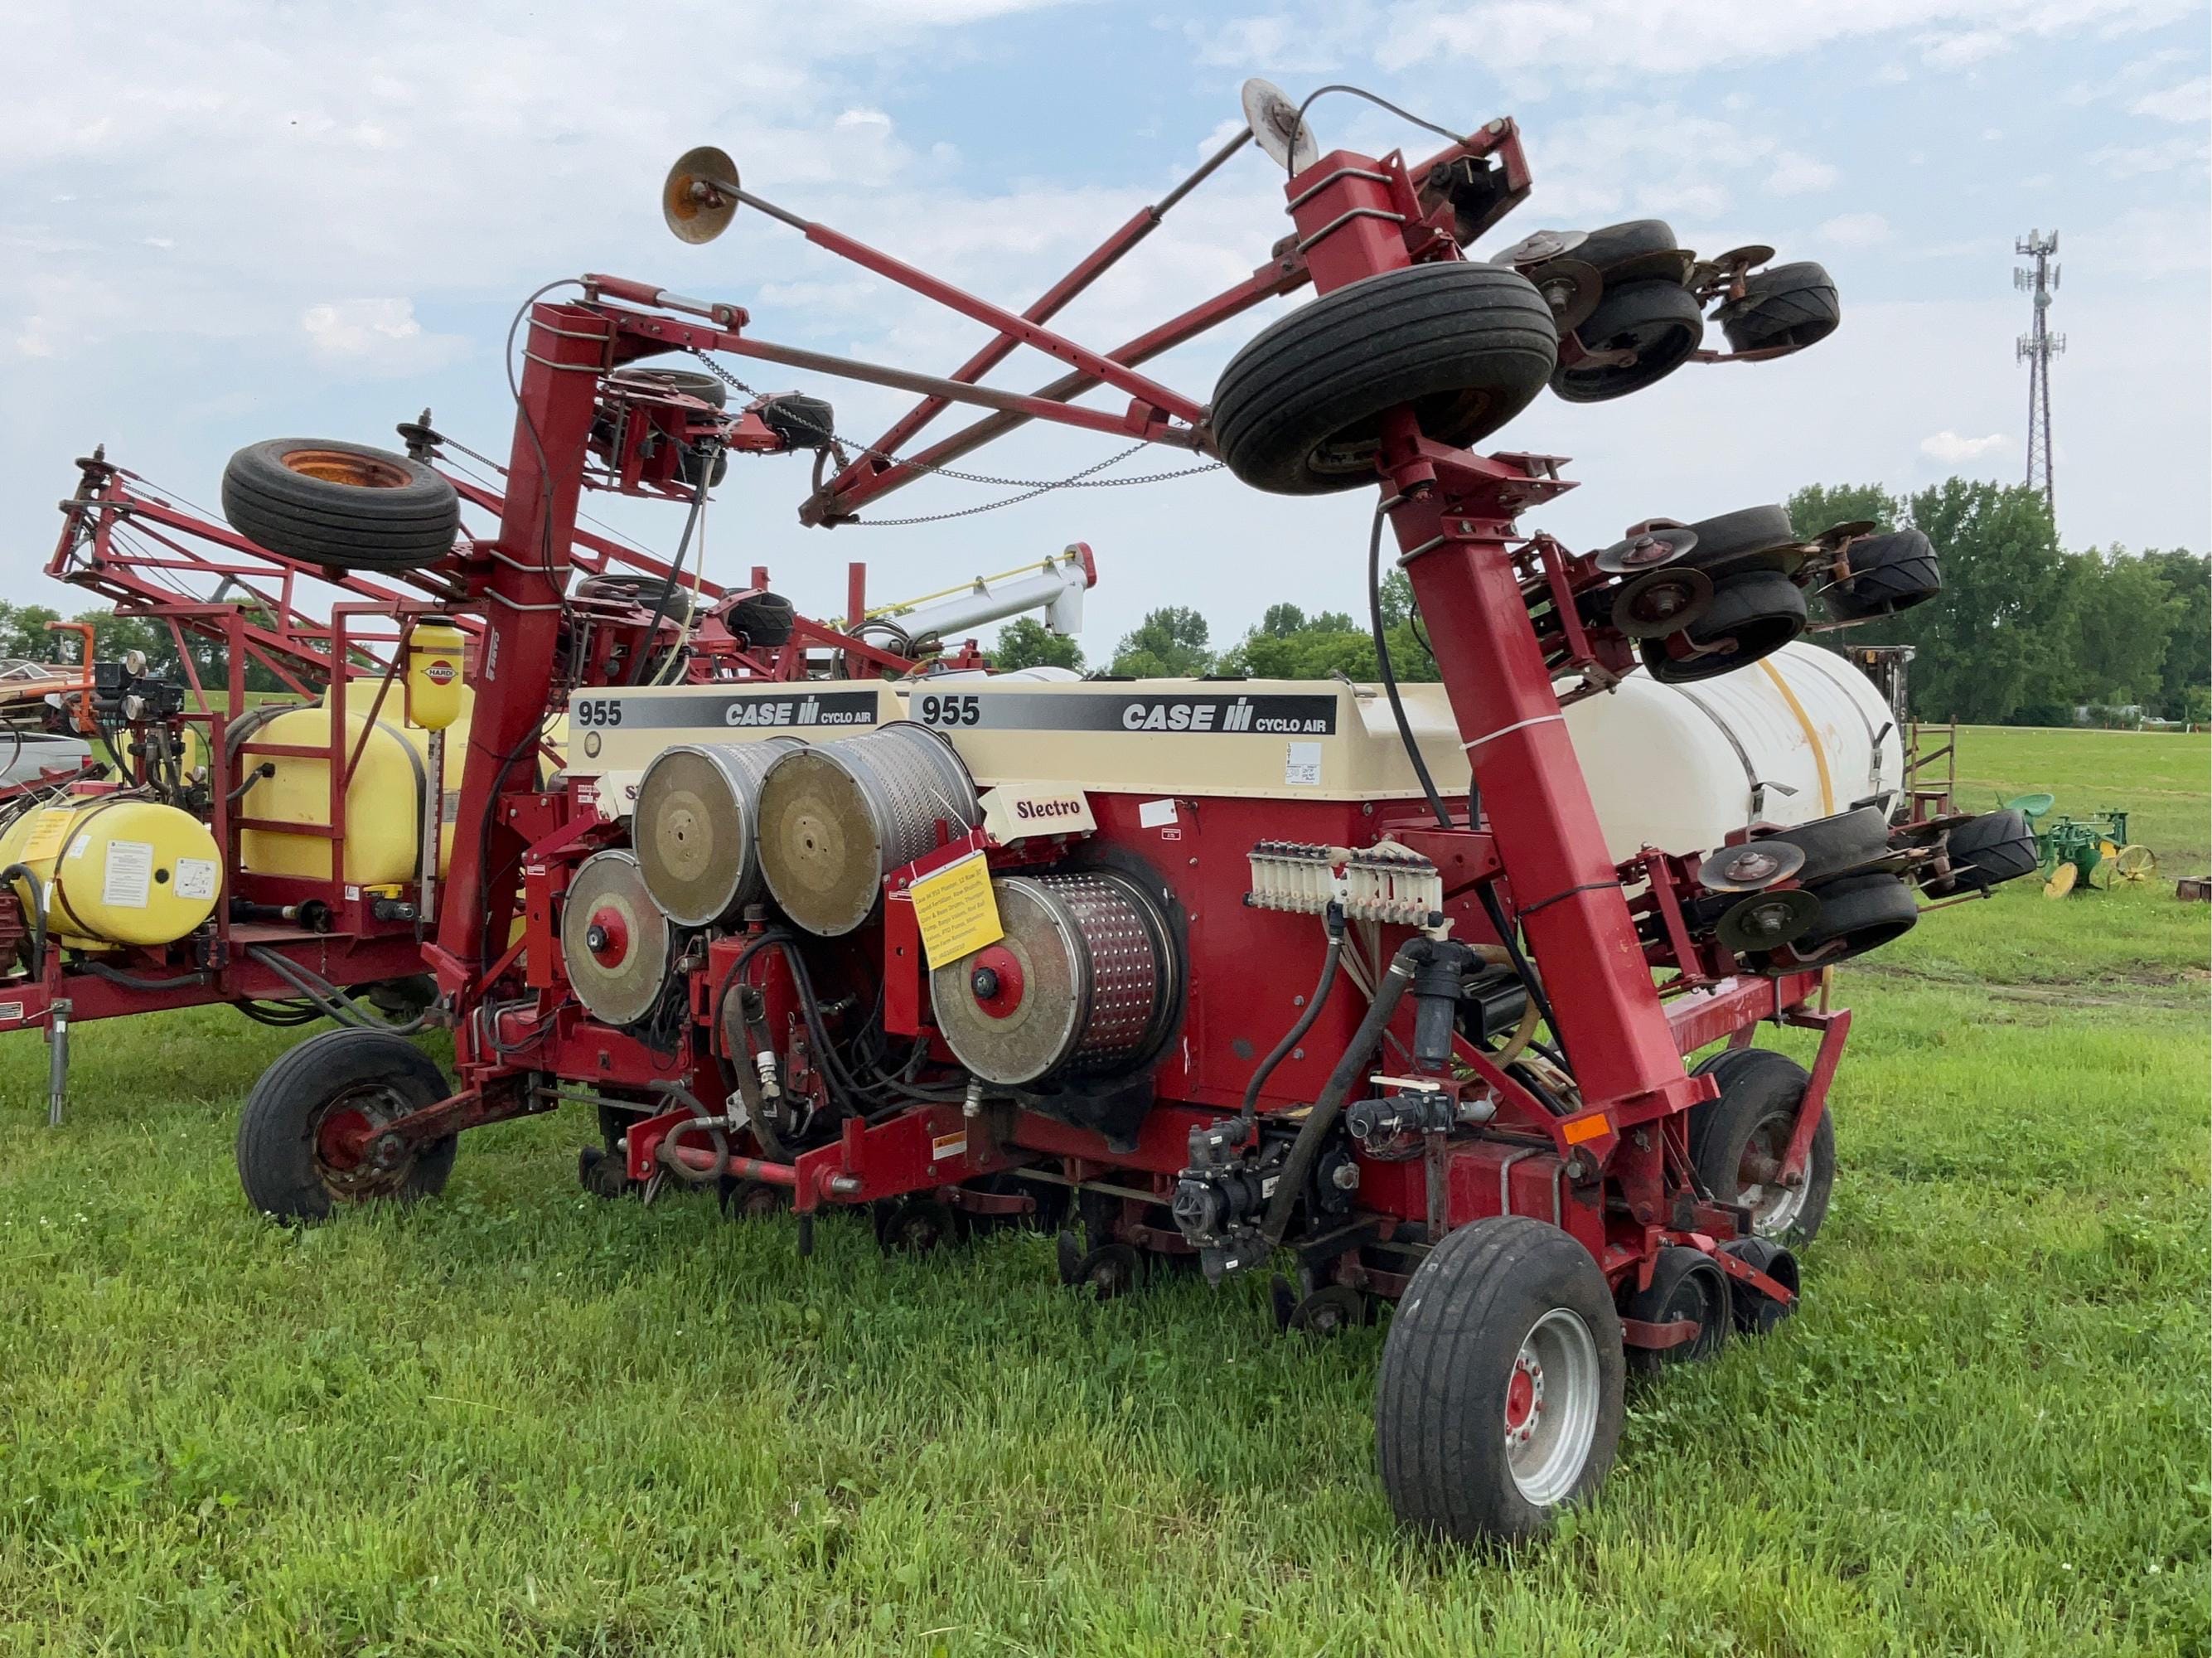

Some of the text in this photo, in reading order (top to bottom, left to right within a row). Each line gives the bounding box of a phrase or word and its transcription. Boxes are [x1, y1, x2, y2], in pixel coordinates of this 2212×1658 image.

[578, 700, 622, 726] 955
[725, 702, 793, 726] CASE
[820, 712, 853, 724] CYCLO
[854, 711, 871, 723] AIR
[922, 696, 980, 726] 955
[1122, 703, 1217, 730] CASE
[1256, 719, 1300, 732] CYCLO
[1302, 720, 1326, 733] AIR
[1016, 800, 1080, 819] Slectro
